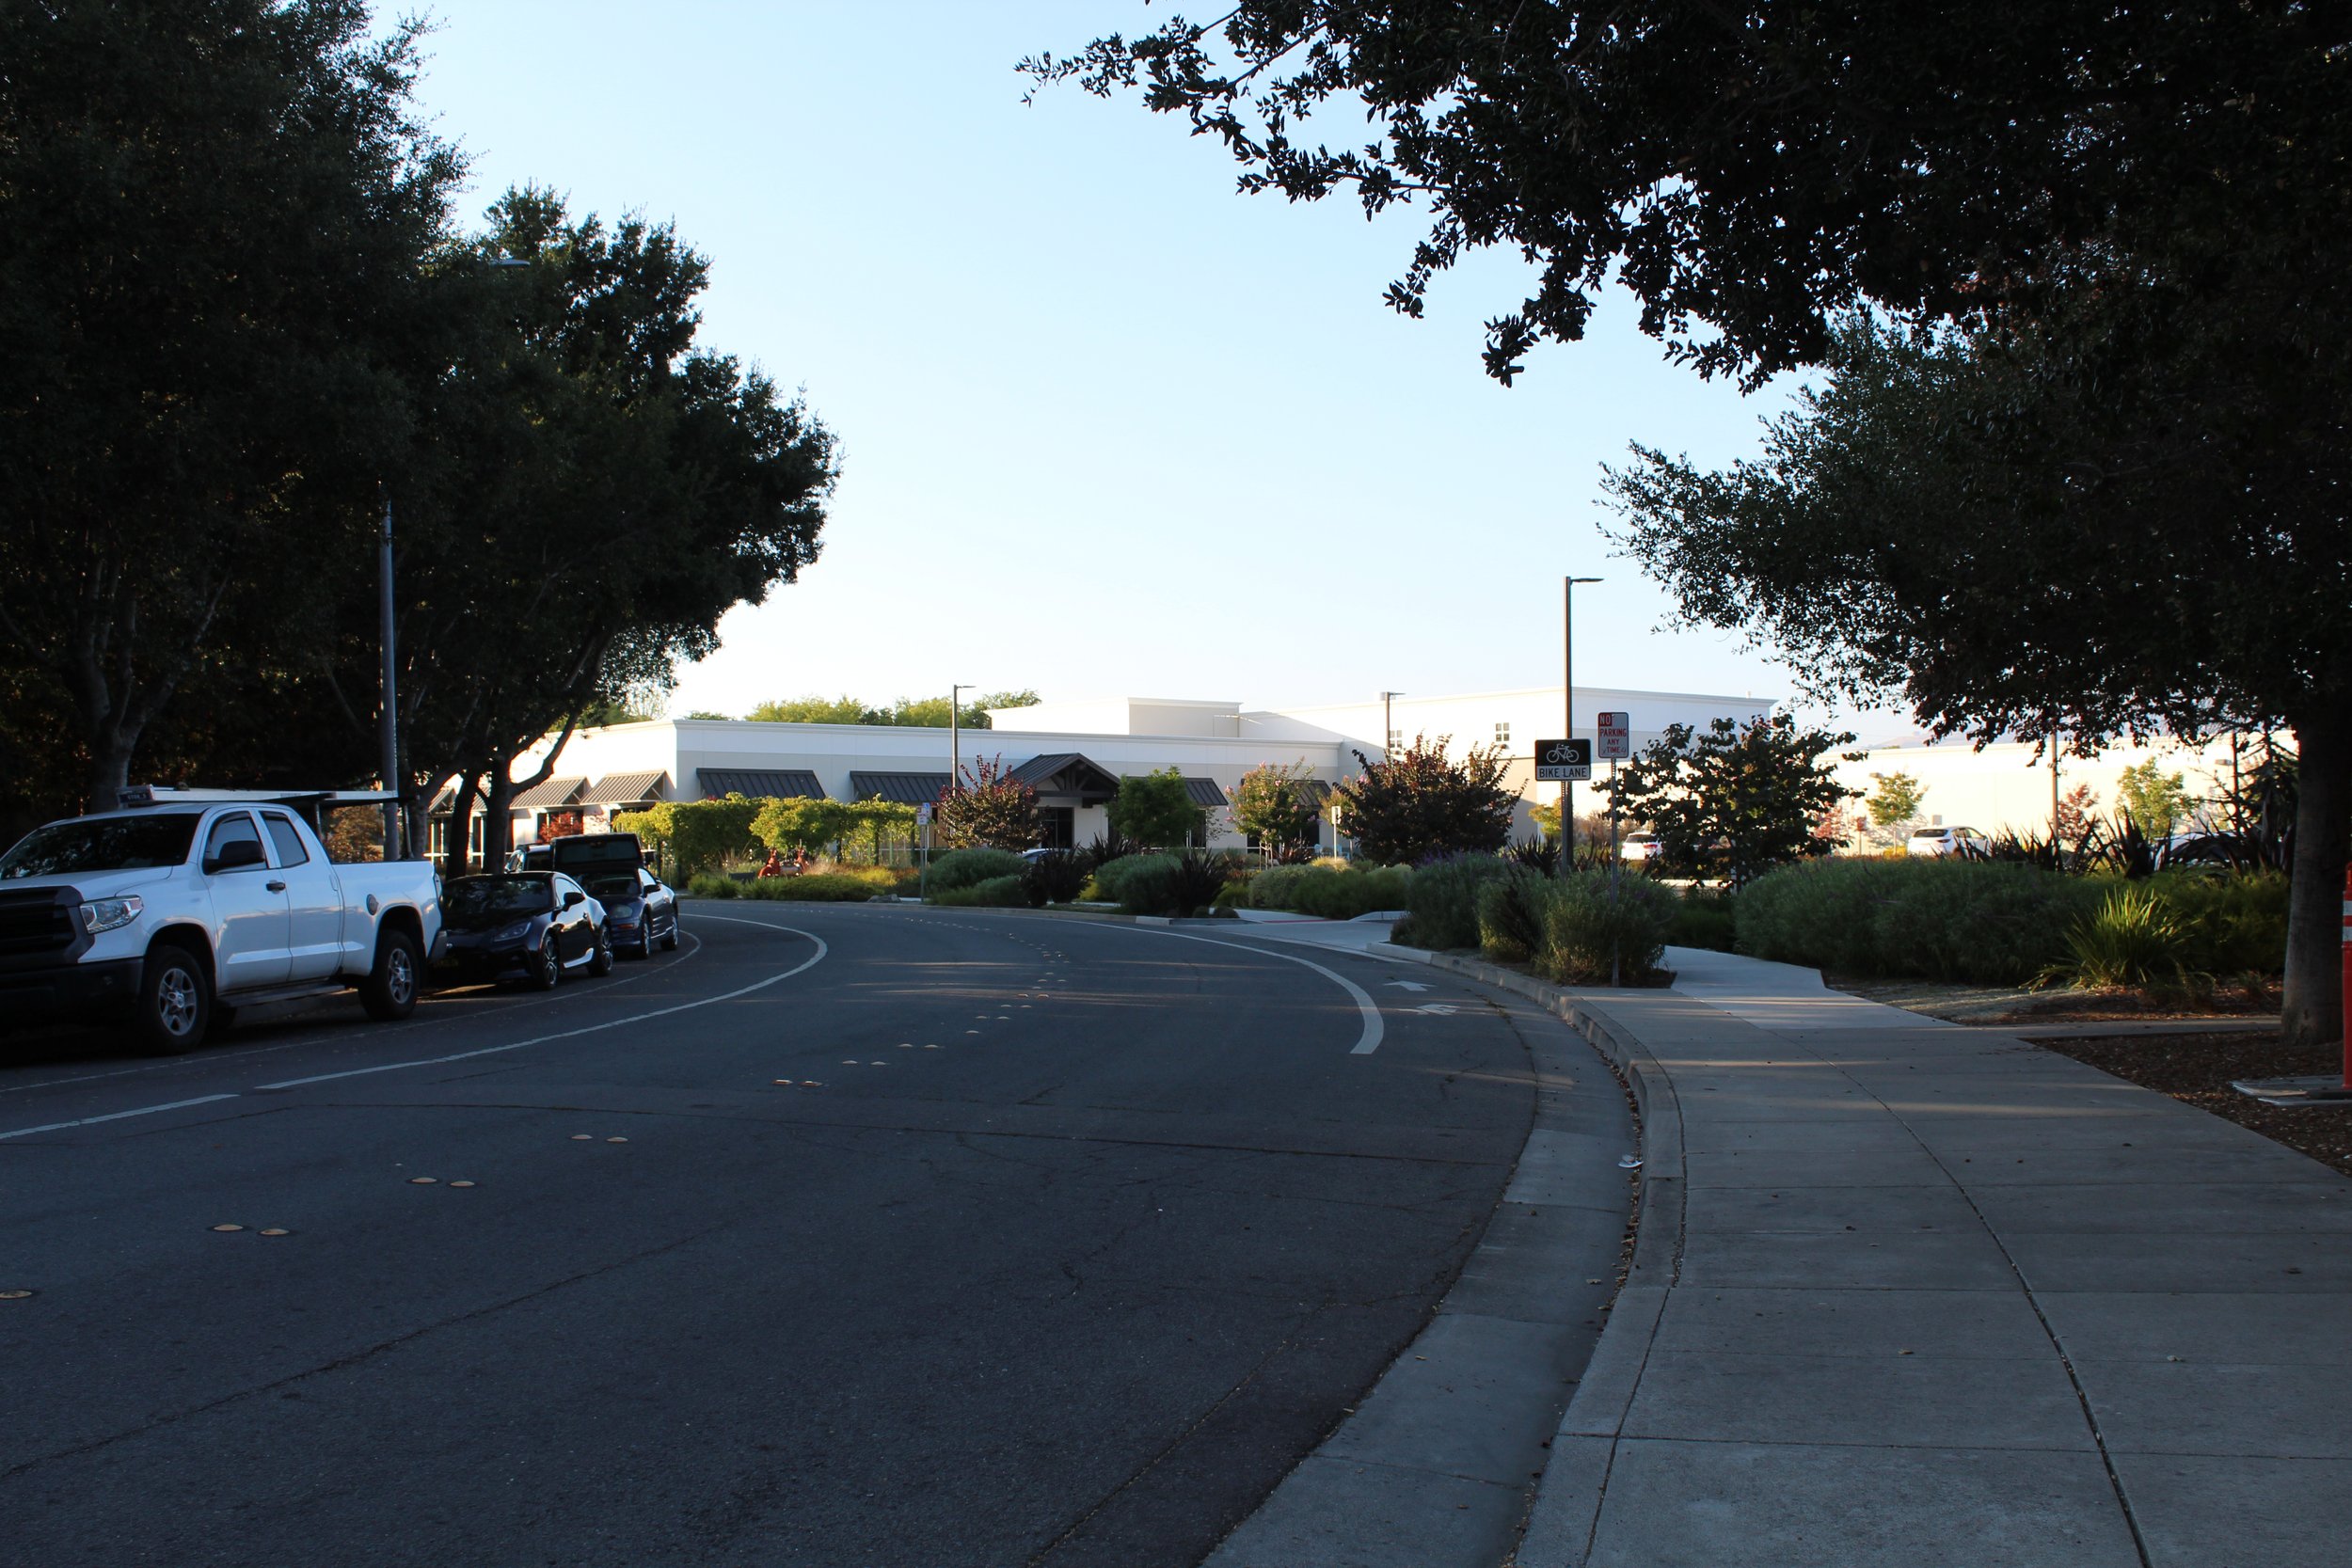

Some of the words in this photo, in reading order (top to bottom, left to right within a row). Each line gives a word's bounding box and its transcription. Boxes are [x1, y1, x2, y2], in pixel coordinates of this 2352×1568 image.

[1599, 715, 1611, 725] NO
[1599, 728, 1627, 737] PARKING
[1539, 768, 1560, 778] BIKE
[1563, 768, 1587, 778] LANE
